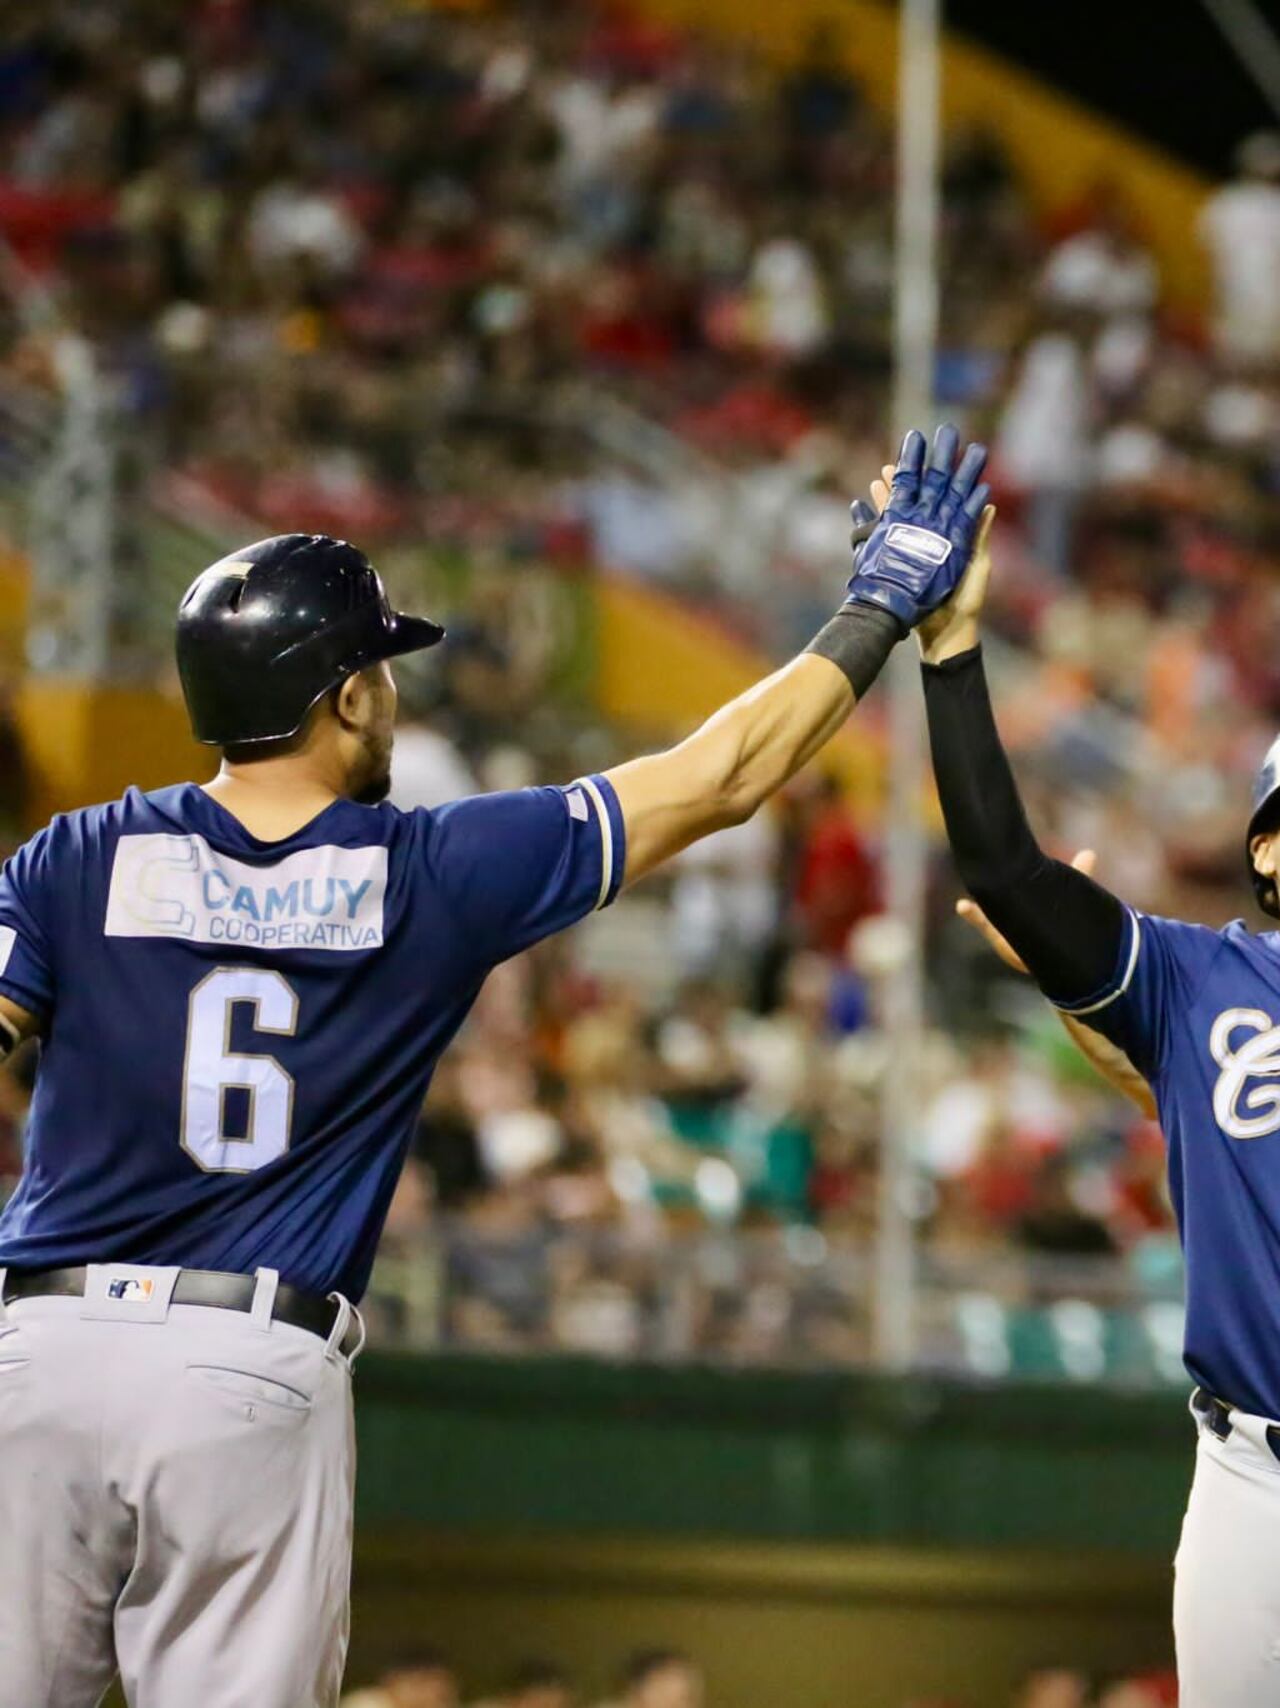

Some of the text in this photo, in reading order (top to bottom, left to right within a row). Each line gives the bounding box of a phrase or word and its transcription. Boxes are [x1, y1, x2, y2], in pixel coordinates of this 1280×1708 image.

[203, 869, 373, 922] CAMUY
[209, 916, 381, 946] COOPERATIVA
[179, 966, 299, 1174] 6
